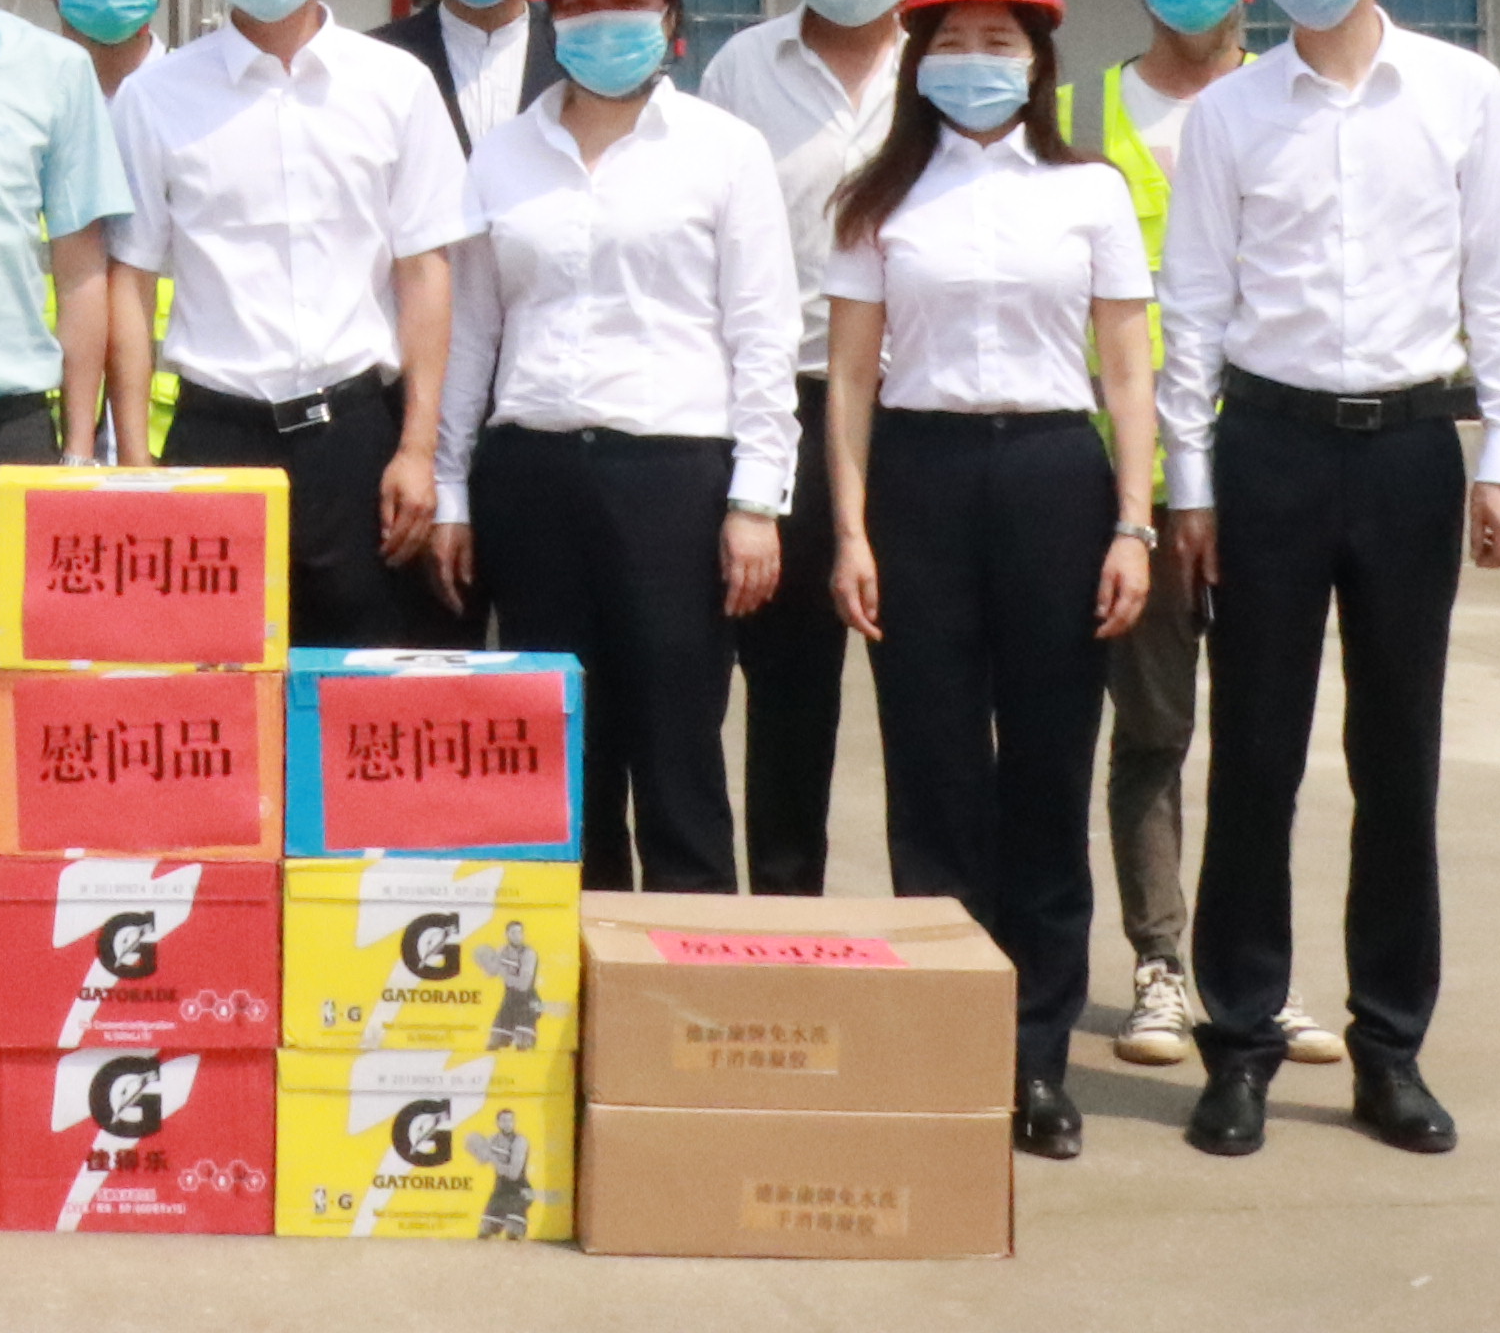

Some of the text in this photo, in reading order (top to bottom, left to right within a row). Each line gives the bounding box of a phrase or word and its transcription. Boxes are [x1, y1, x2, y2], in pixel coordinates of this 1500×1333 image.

[46, 533, 239, 596] 慰问品
[41, 716, 233, 783] 慰问品
[345, 716, 539, 783] 慰问品
[96, 911, 157, 979] G
[400, 911, 461, 981] G
[78, 986, 179, 1004] GATORADE
[381, 988, 482, 1006] GATORADE
[88, 1055, 163, 1138] G
[86, 1148, 169, 1173] 佳得乐
[391, 1098, 452, 1167] G
[373, 1174, 474, 1192] GATORADE
